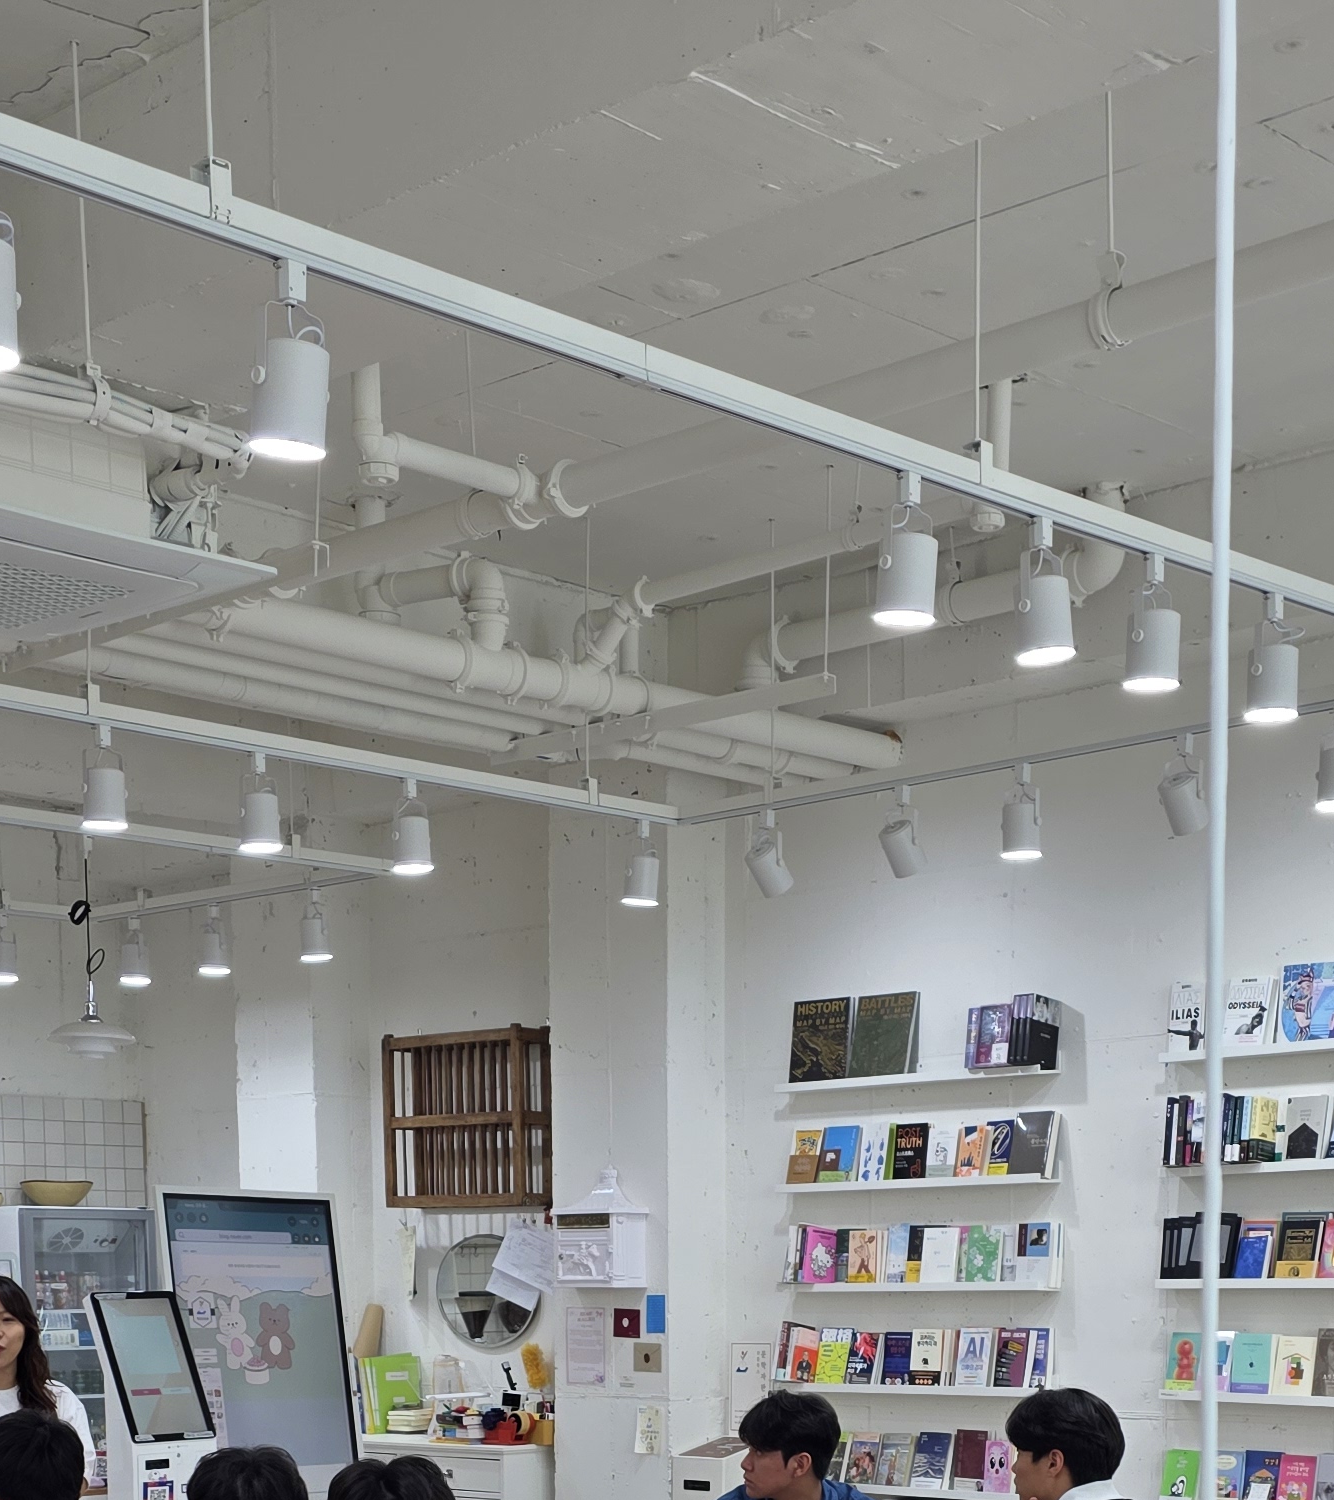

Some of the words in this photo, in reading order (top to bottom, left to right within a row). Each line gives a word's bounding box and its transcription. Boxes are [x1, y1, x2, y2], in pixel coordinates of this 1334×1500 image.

[797, 1000, 847, 1015] HISTORY
[861, 995, 914, 1010] BATTLES
[1171, 1006, 1200, 1020] ILIAS
[898, 1126, 923, 1139] POST-
[897, 1137, 923, 1149] TRUTH
[965, 1336, 984, 1359] AI
